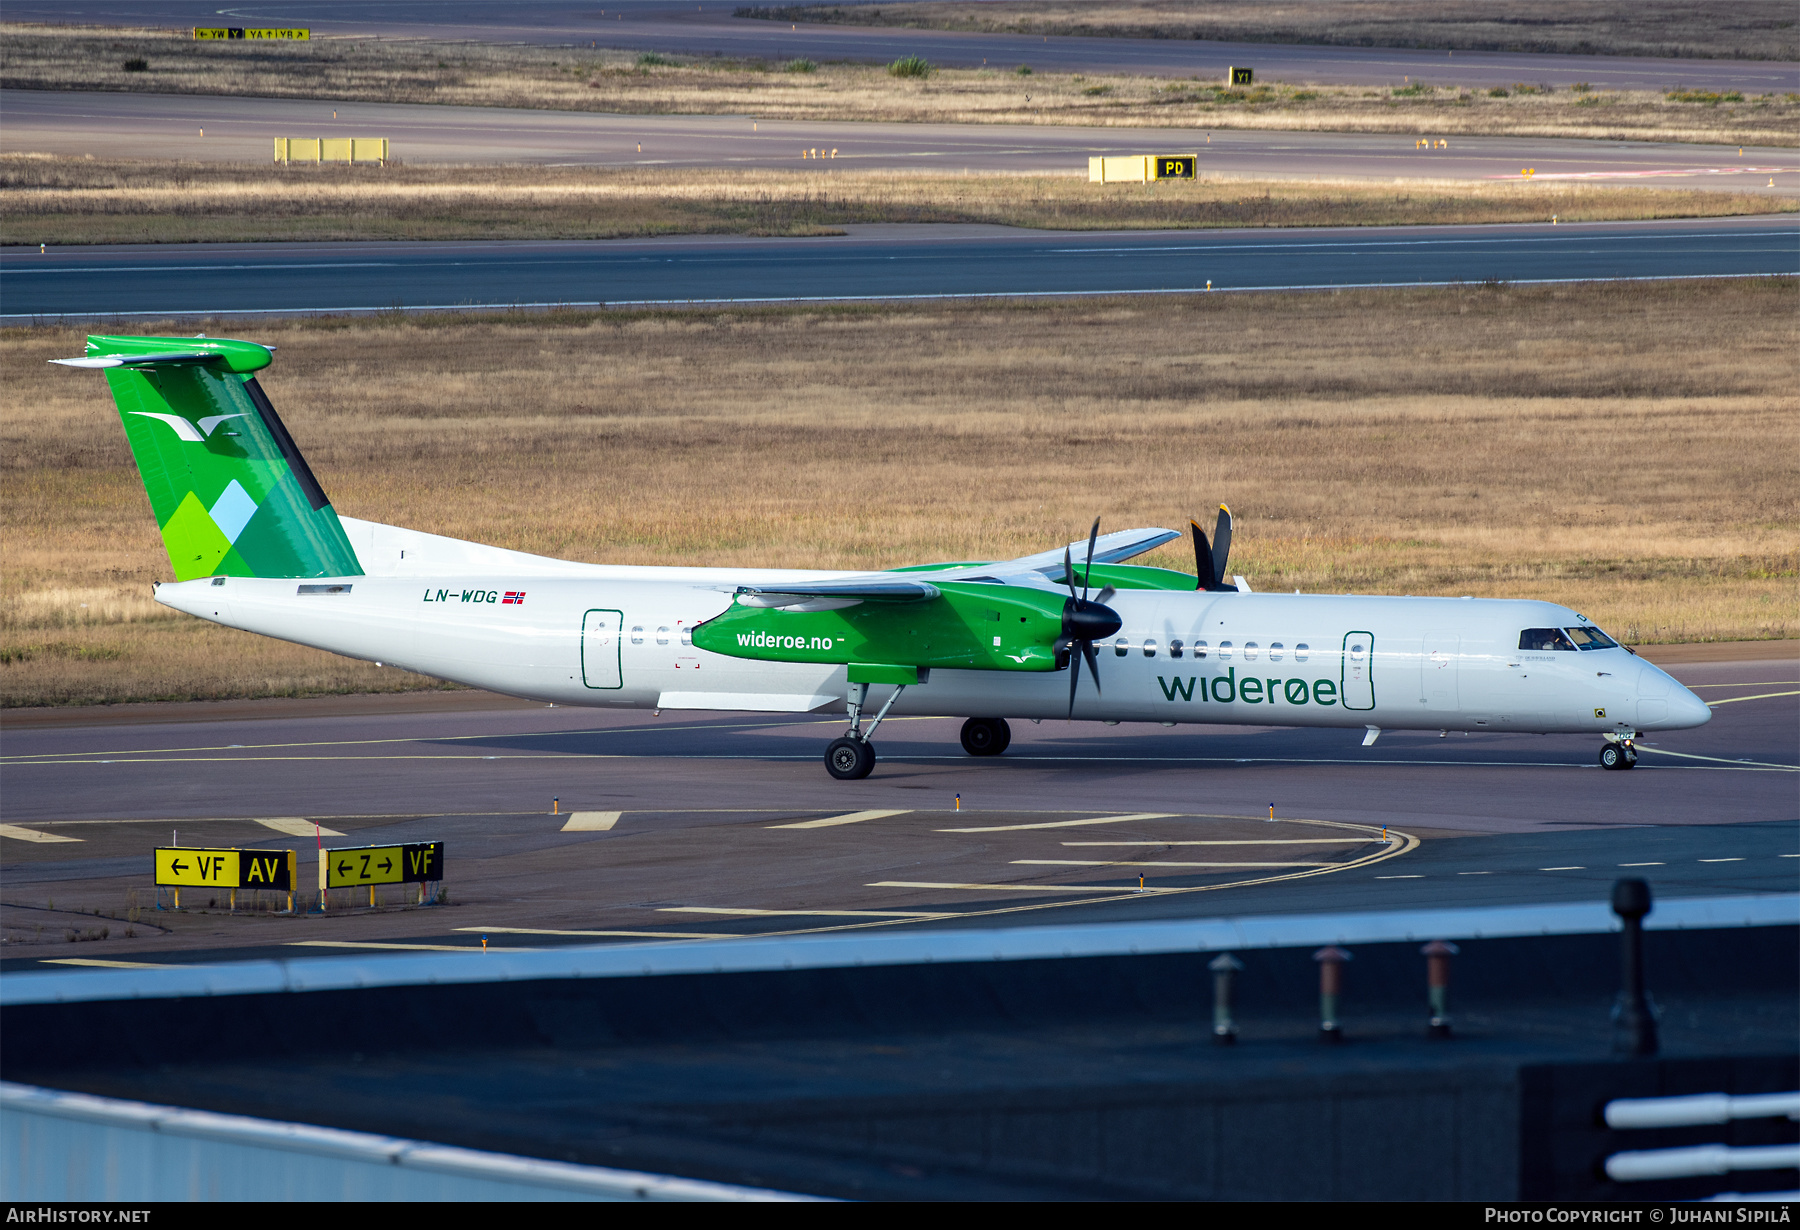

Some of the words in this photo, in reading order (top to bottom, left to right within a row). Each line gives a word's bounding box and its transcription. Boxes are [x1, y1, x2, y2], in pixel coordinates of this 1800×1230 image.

[211, 30, 225, 39] YW
[232, 30, 239, 38] Y
[250, 30, 263, 39] YA
[1237, 73, 1249, 82] Y1
[1166, 161, 1184, 175] PD
[423, 588, 498, 604] LN-WDG
[736, 630, 833, 650] wideroe.no
[1157, 666, 1337, 706] widerøe
[197, 856, 225, 880] VF
[247, 858, 279, 883] AV
[360, 855, 371, 879] Z
[410, 849, 434, 875] VF
